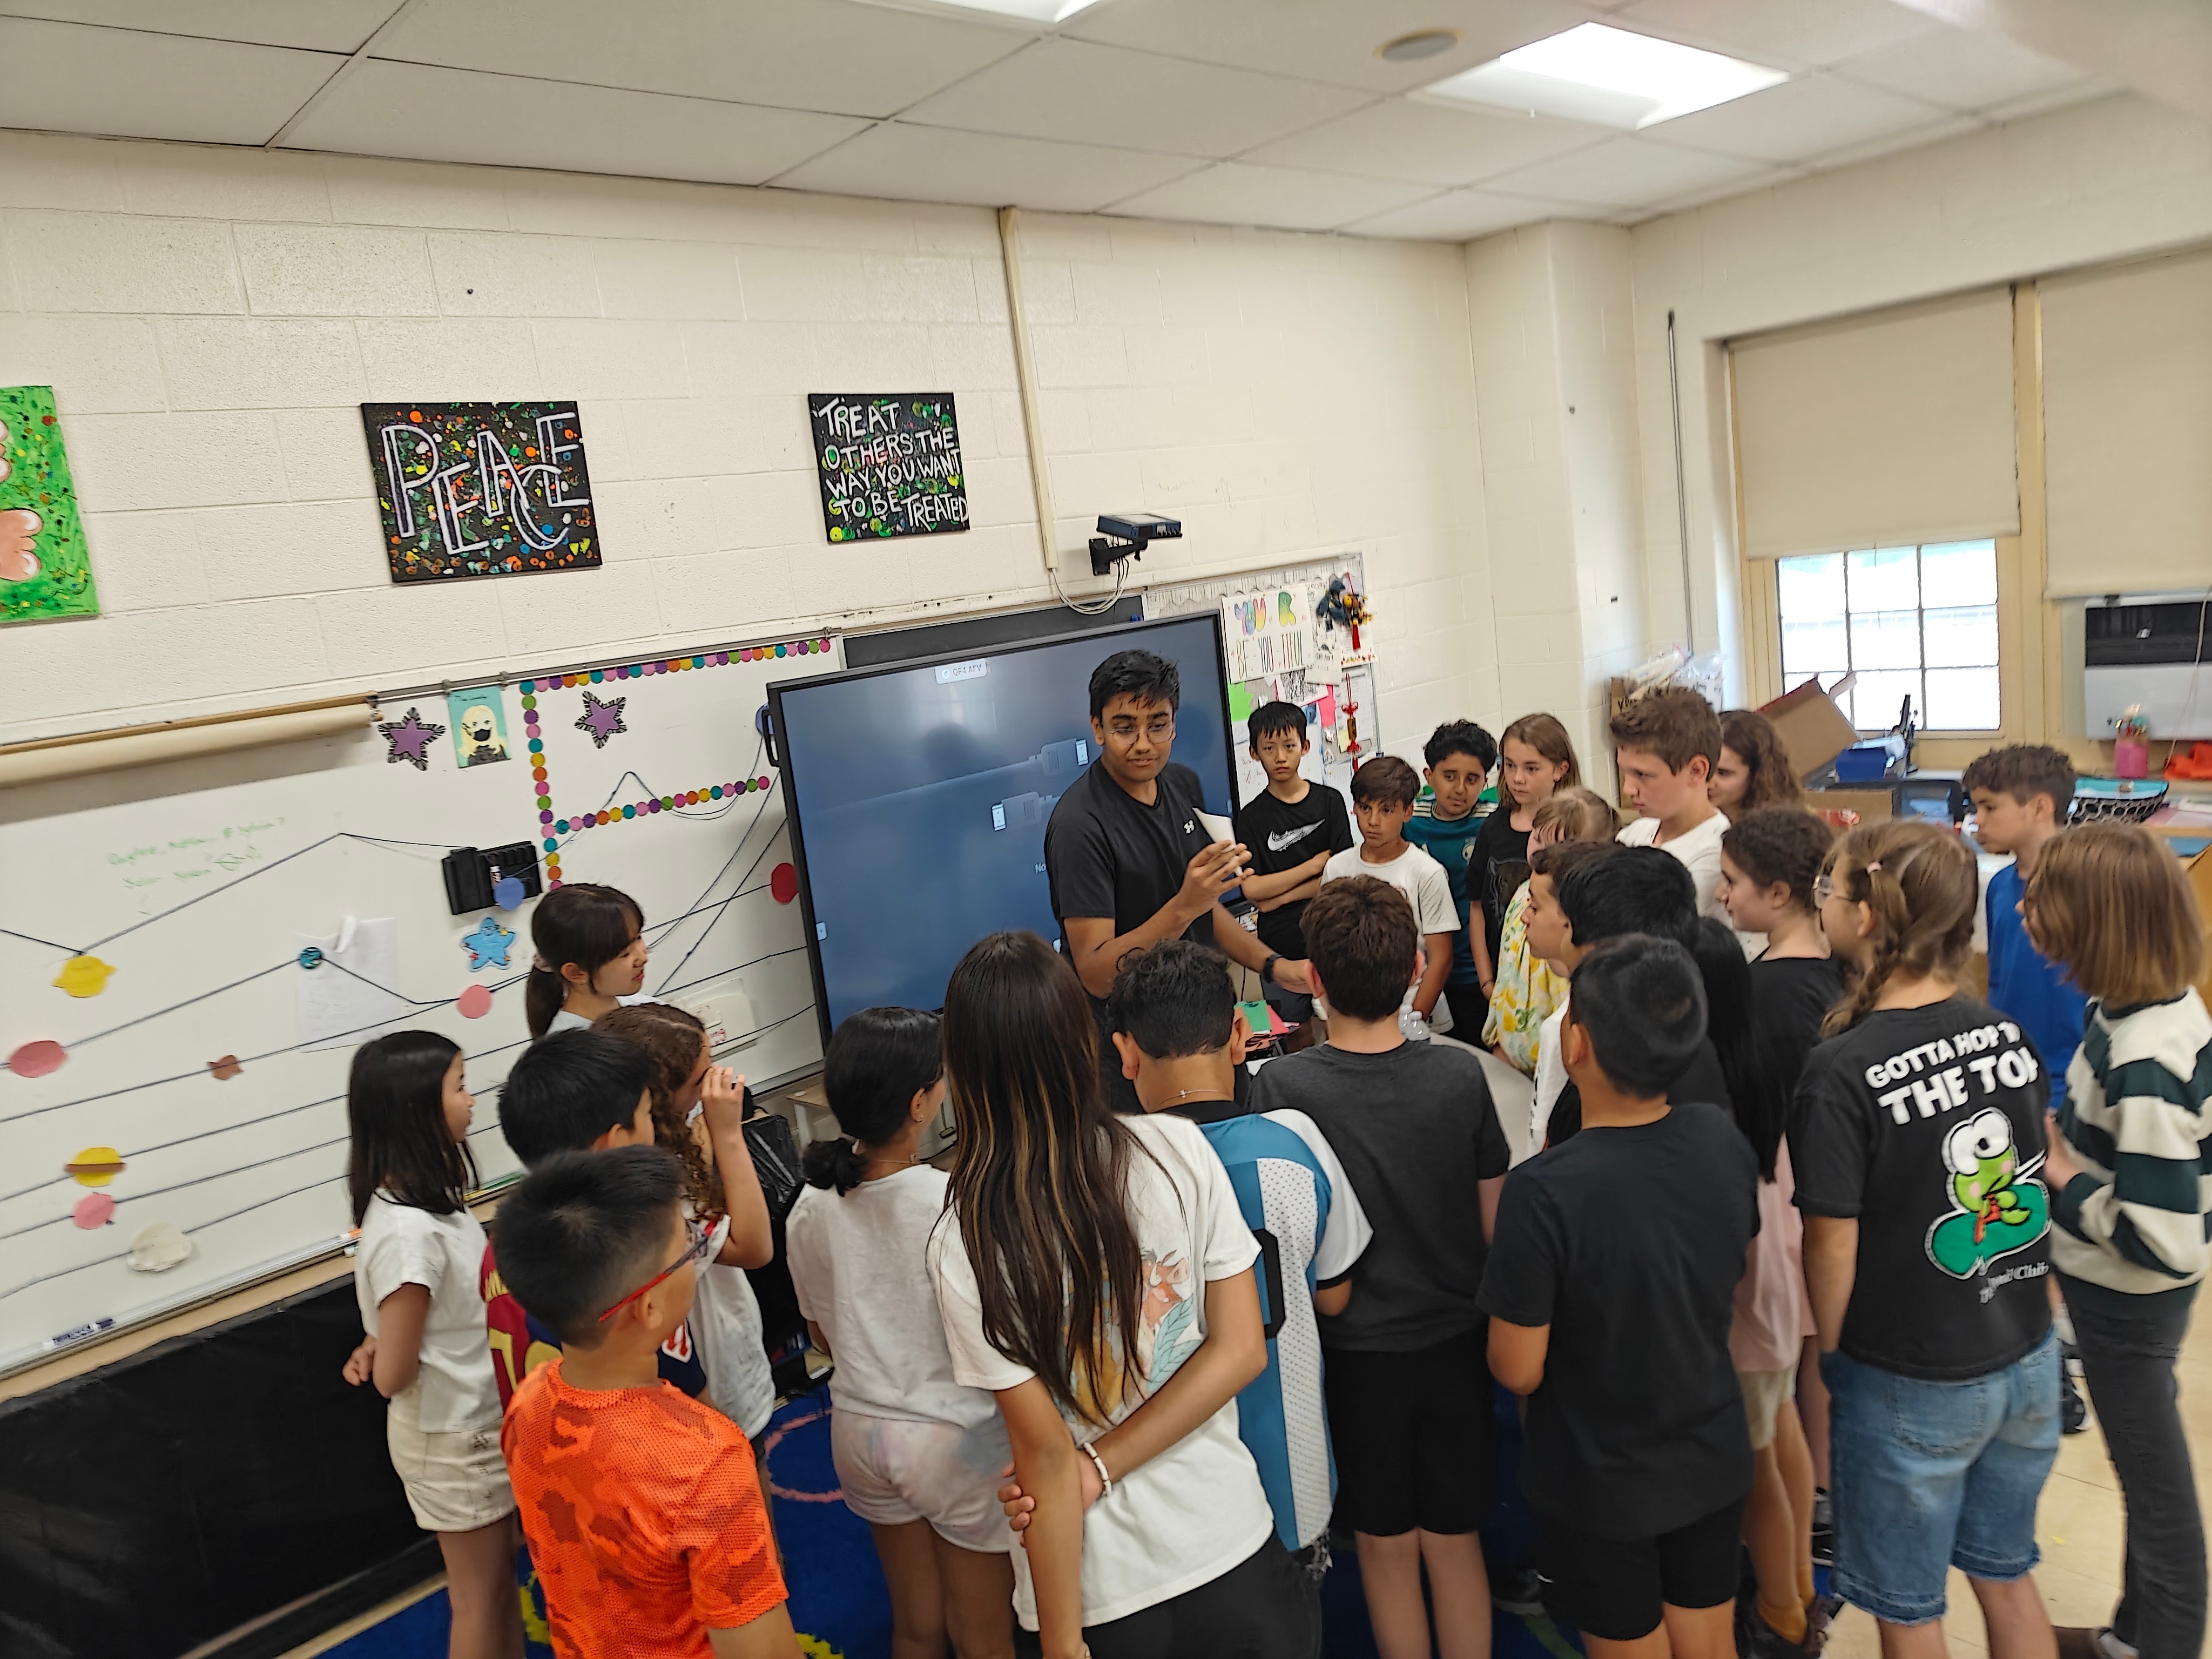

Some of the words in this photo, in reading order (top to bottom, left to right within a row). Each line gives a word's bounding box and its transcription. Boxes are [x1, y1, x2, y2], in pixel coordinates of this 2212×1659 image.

[818, 397, 900, 444] TREAT
[825, 434, 914, 470] OTHERS
[916, 427, 955, 453] THE
[381, 412, 590, 555] PEACE
[826, 467, 871, 500] WAY
[875, 458, 915, 488] YOU
[917, 448, 960, 480] WANT
[833, 497, 866, 522] TO
[871, 489, 902, 516] BE
[901, 493, 968, 532] TREATED
[1235, 598, 1266, 636] YOU
[1278, 592, 1297, 627] R
[1865, 1038, 1956, 1089] GOTTA
[1952, 1025, 1999, 1057] HOP
[1877, 1065, 1969, 1125] THE
